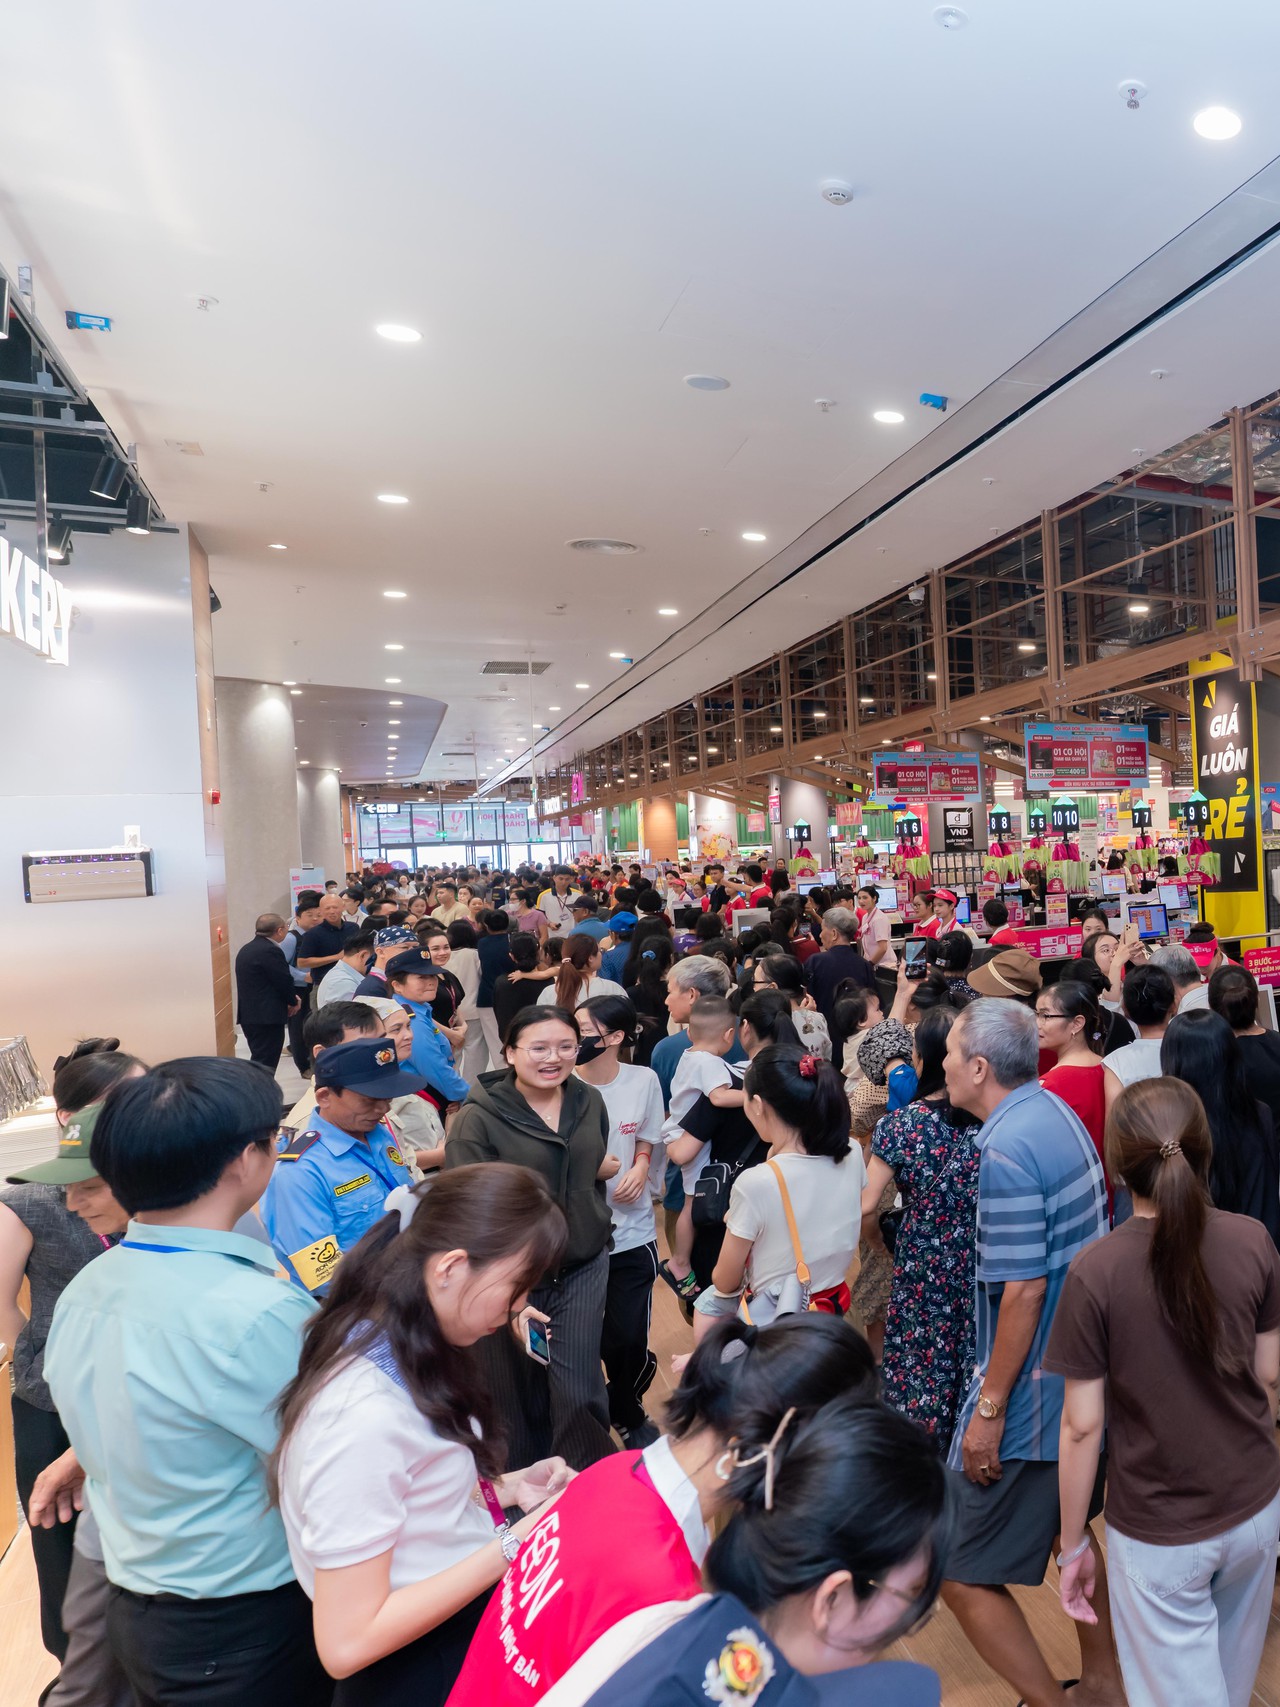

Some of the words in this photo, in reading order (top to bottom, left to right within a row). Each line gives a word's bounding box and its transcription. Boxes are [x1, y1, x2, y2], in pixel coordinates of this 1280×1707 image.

[1210, 703, 1239, 739] GIÁ
[1053, 748, 1061, 756] 01
[1074, 746, 1087, 758] HỘI
[1116, 744, 1125, 754] 01
[1116, 757, 1126, 766] 01
[1201, 742, 1249, 777] LUÔN
[1189, 806, 1195, 821] 9
[1201, 805, 1208, 820] 9
[1204, 777, 1250, 840] RẺ
[1001, 816, 1008, 829] 8
[1039, 817, 1044, 828] 5
[1053, 811, 1063, 825] 10
[1064, 810, 1078, 825] 10
[1134, 813, 1139, 824] 7
[1144, 811, 1149, 823] 7
[802, 828, 808, 838] 4
[912, 822, 918, 833] 6
[950, 828, 968, 836] VND
[1248, 959, 1253, 967] 3
[1254, 956, 1272, 966] BƯỚC
[513, 1655, 540, 1688] BẢN
